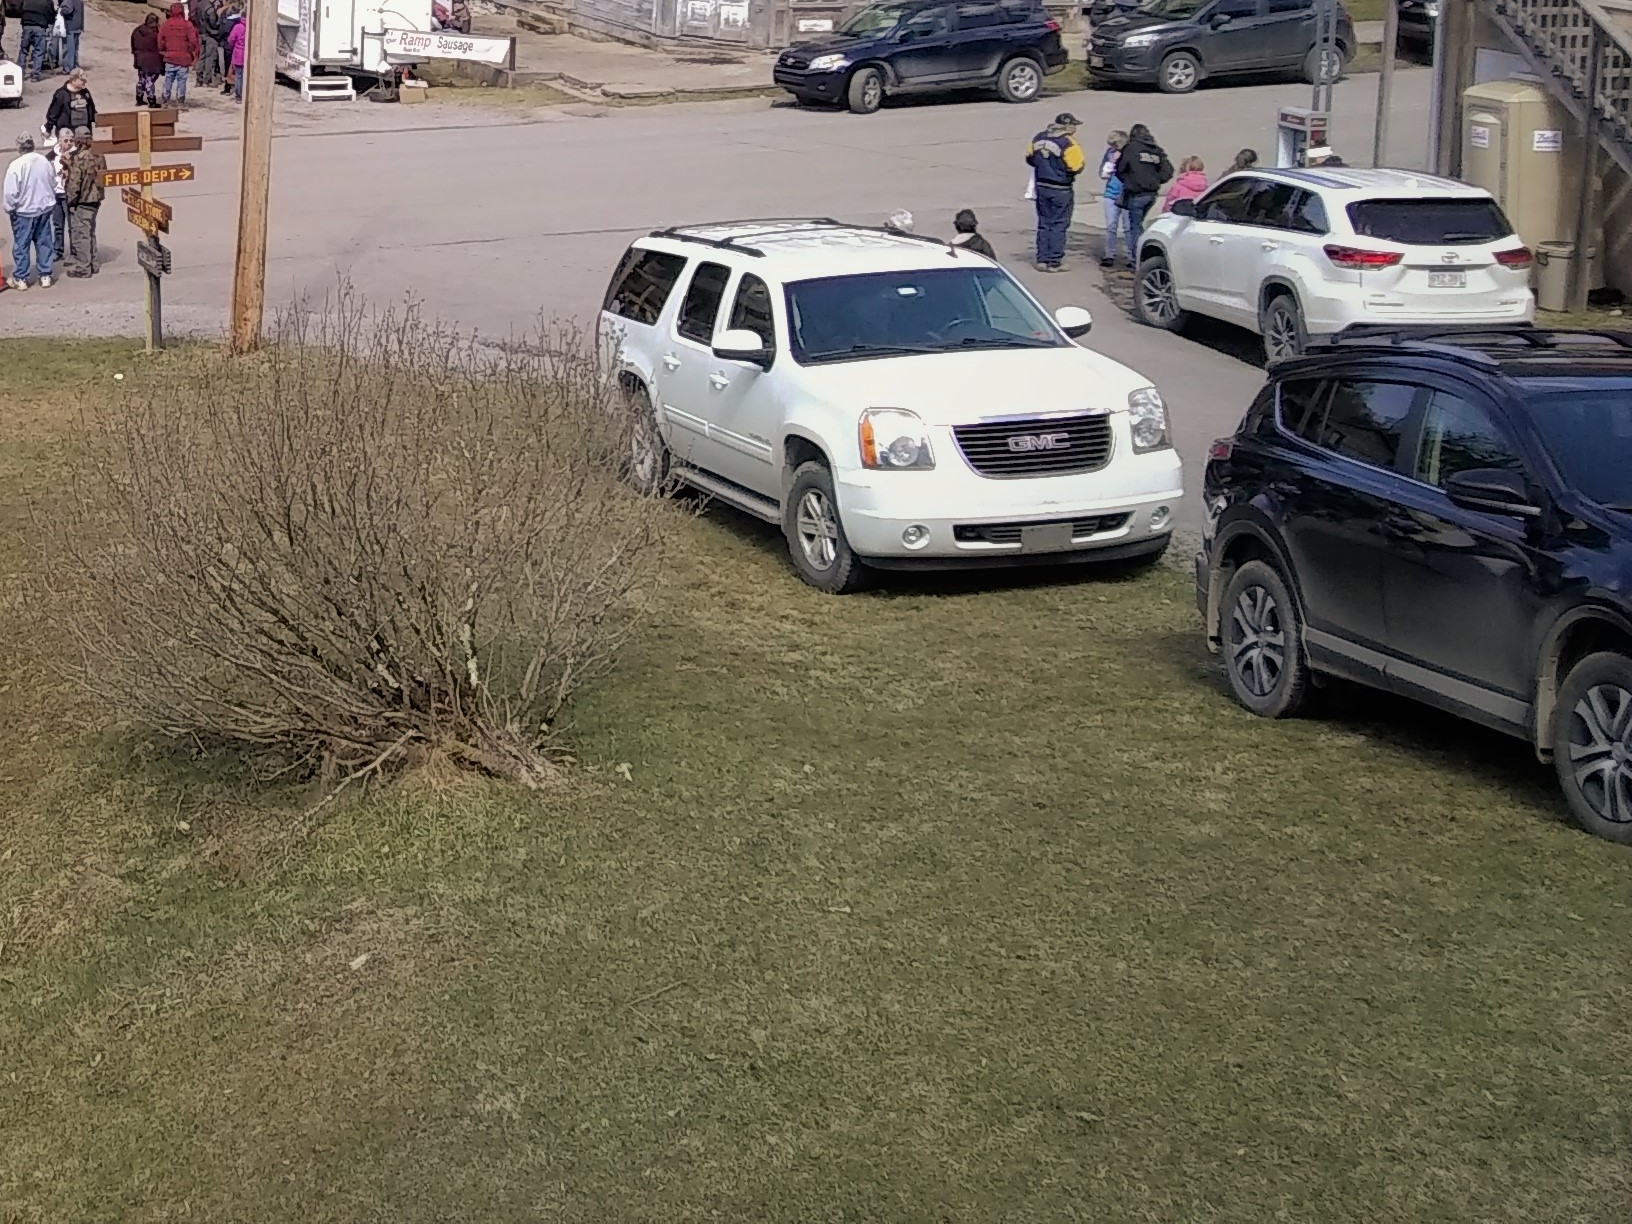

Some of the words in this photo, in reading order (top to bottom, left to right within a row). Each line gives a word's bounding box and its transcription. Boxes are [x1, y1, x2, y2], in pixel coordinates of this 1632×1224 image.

[399, 32, 432, 50] Ramp
[436, 36, 474, 54] Sausage
[105, 172, 138, 186] FIRE
[143, 169, 176, 183] DEPT
[1008, 432, 1071, 452] GMC
